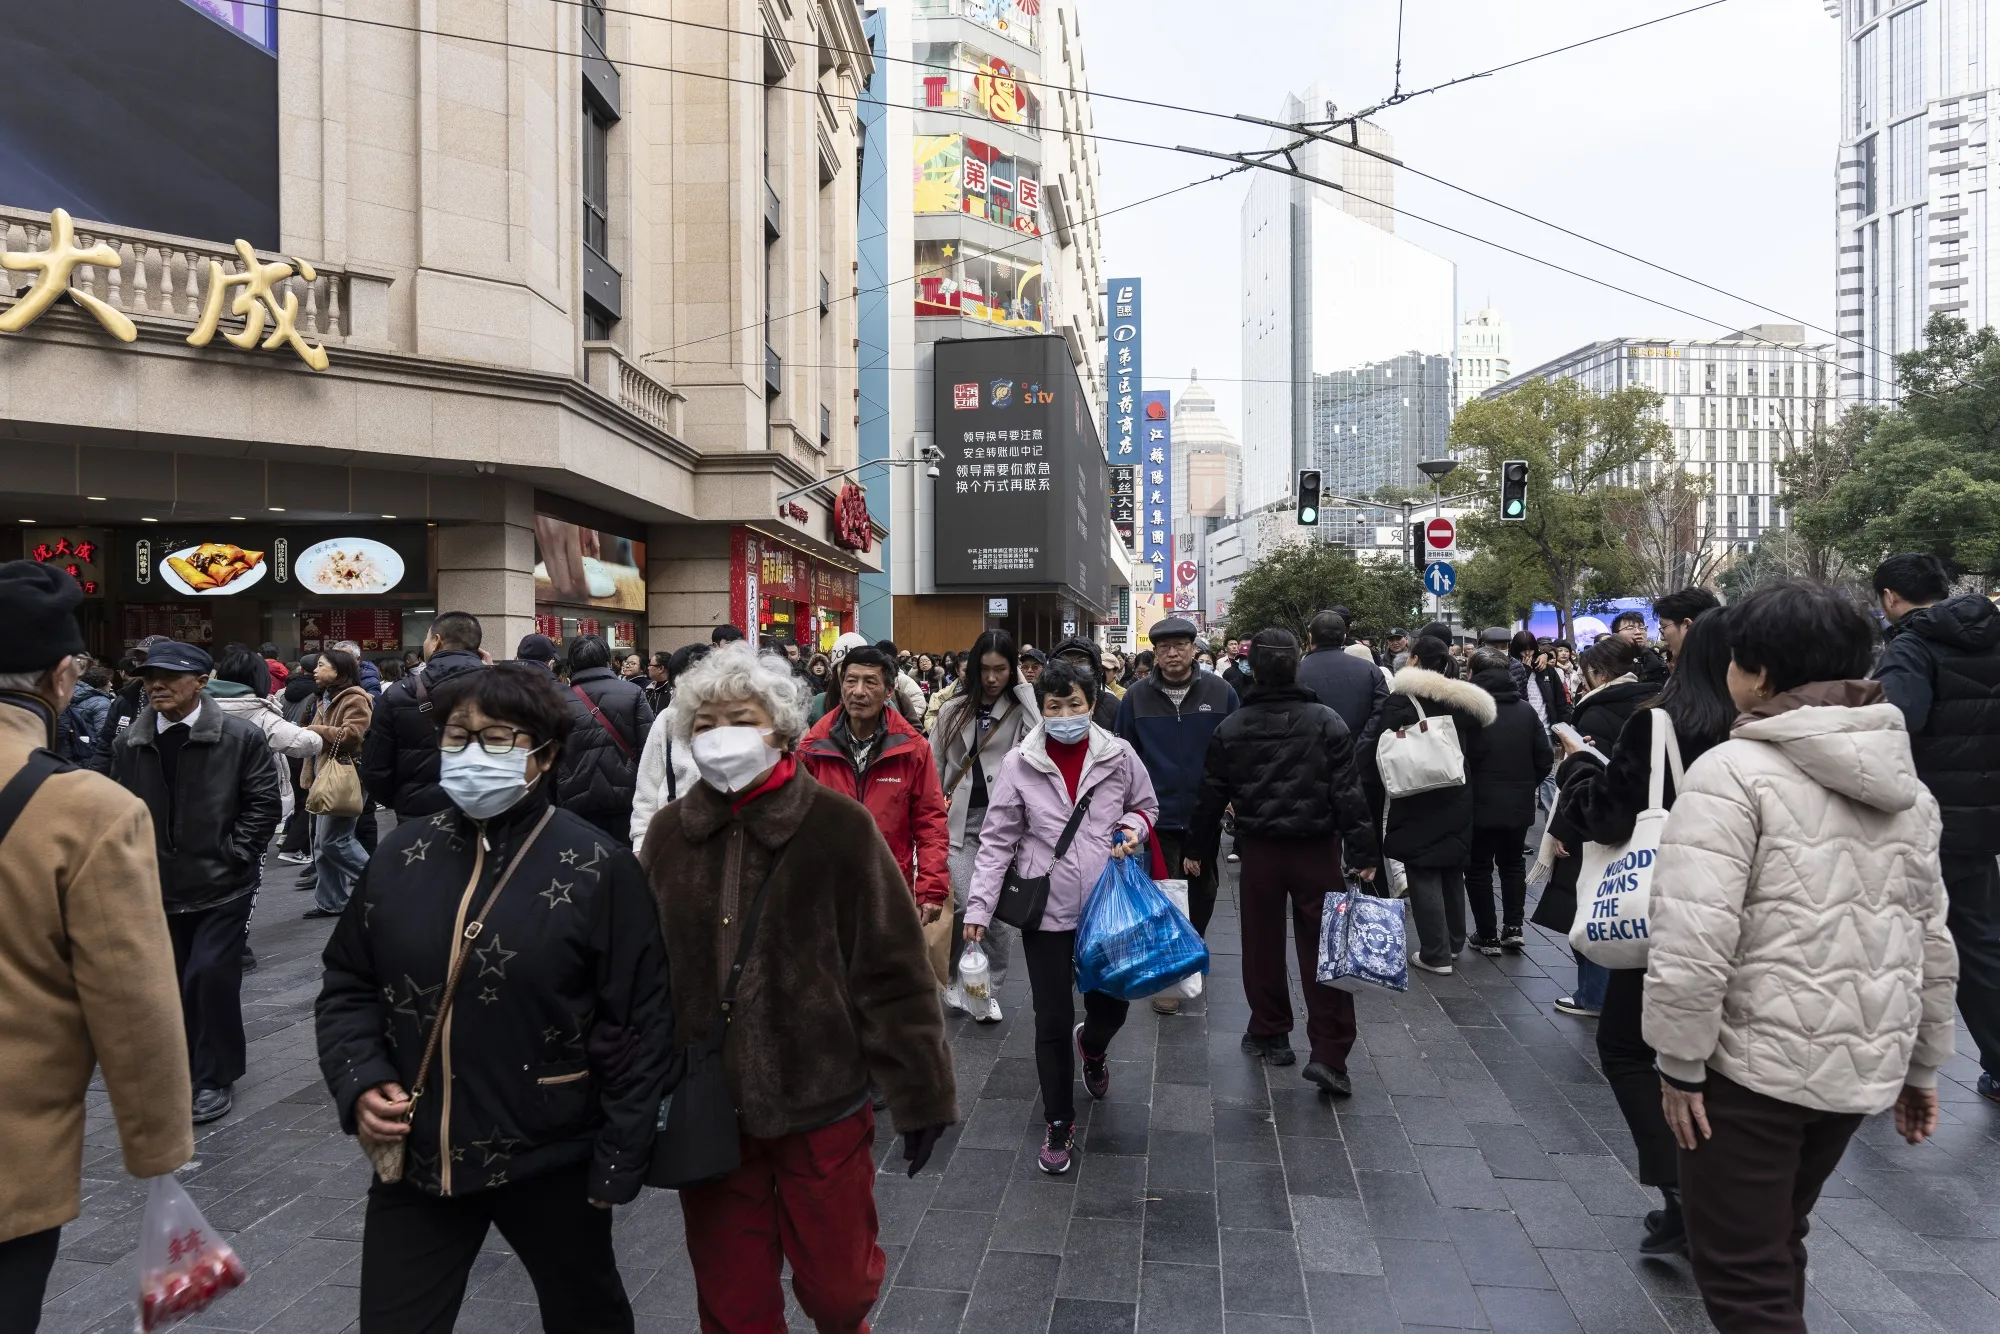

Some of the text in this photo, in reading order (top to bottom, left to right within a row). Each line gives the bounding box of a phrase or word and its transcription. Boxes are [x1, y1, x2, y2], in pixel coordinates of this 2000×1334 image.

[963, 157, 1039, 211] 第一医
[0, 208, 330, 371] 大成
[1024, 387, 1054, 404] sitv
[1117, 346, 1134, 455] 第一医药商店
[963, 429, 1043, 443] 领导换号要注意
[963, 445, 1043, 459] 安全转账心中记
[956, 462, 1051, 478] 领导需要你救急
[956, 478, 1051, 494] 换个方式再联系
[1116, 468, 1133, 521] 真丝大王
[1597, 873, 1638, 898] OWNS
[1592, 898, 1619, 918] THE
[1587, 918, 1648, 941] BEACH
